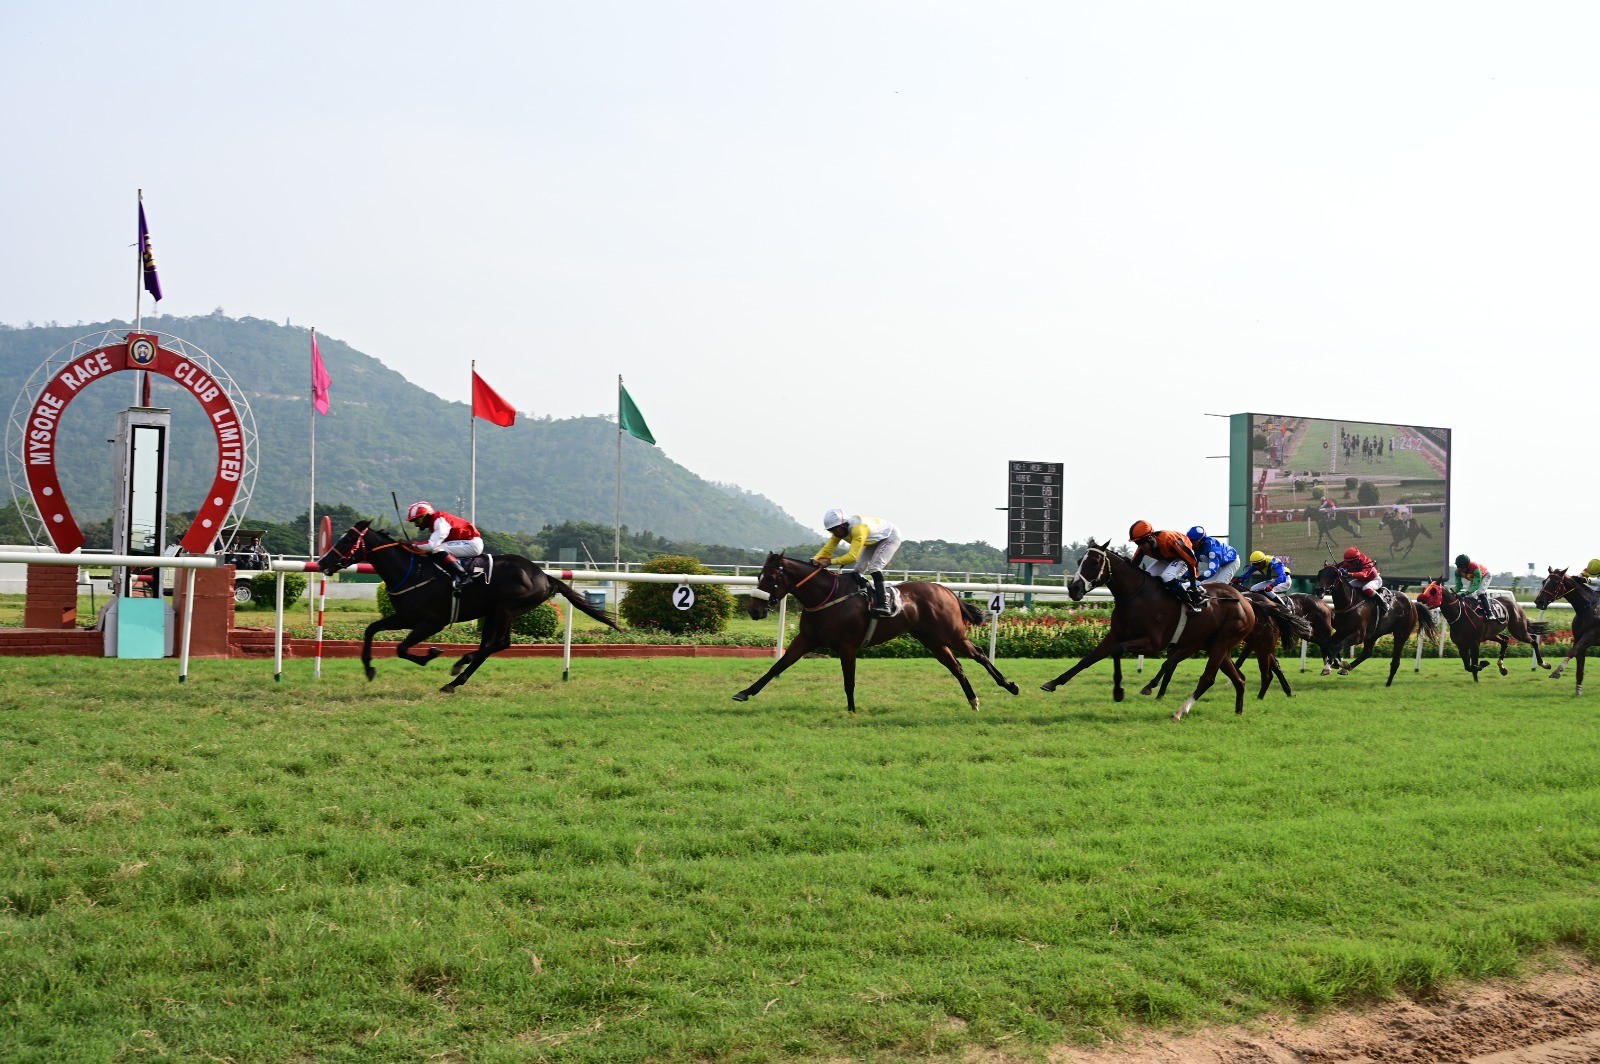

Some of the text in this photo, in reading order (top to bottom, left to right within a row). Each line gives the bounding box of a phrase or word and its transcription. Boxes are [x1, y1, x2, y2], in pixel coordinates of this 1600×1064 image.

[30, 351, 241, 482] MYSORE RACE CLUB LIMITED
[677, 586, 690, 607] 2
[990, 595, 1001, 613] 4
